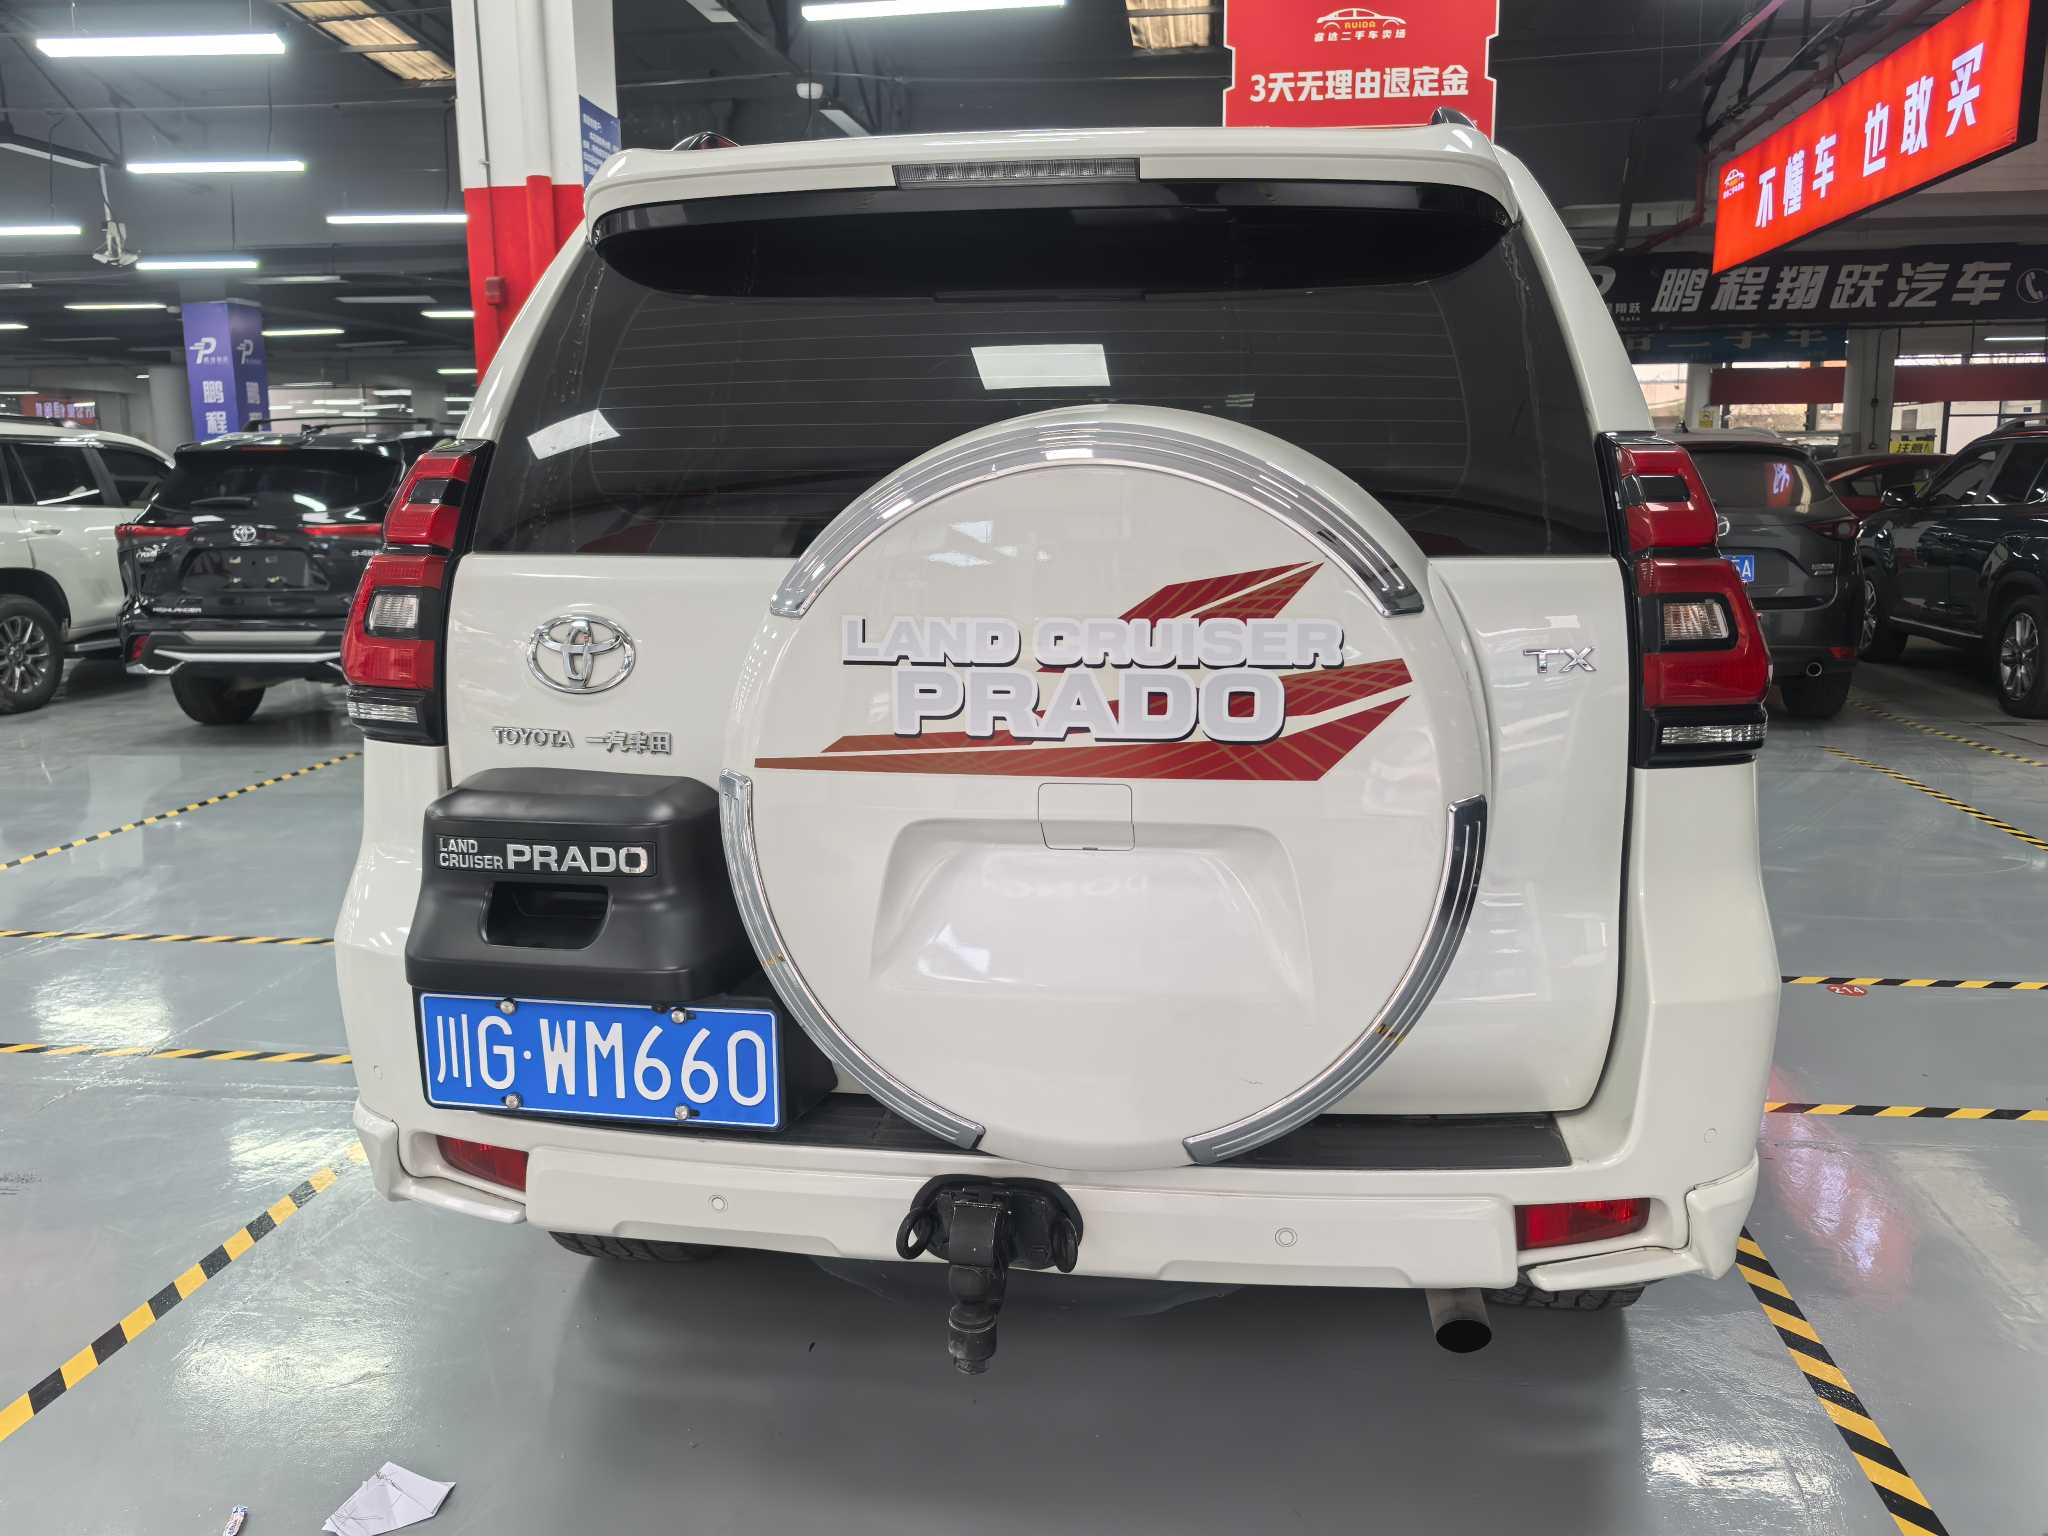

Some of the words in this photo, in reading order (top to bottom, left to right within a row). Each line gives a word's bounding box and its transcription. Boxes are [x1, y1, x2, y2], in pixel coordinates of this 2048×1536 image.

[1250, 64, 1469, 103] 3天无理由退定金
[1755, 134, 1837, 228] 不懂车
[1863, 43, 1984, 177] 也敢买
[1651, 261, 2012, 313] 鹏程翔跃汽车
[842, 614, 1021, 667] LAND
[1034, 615, 1344, 670] CRUISER
[1523, 646, 1597, 674] TX
[894, 668, 1286, 743] PRADO
[493, 726, 576, 749] TOYOTA
[585, 730, 672, 755] 一汽丰田
[439, 837, 478, 853] LAND
[439, 852, 503, 870] CRUISER
[506, 843, 648, 875] PRADO
[437, 1013, 767, 1107] 川G·WM660
